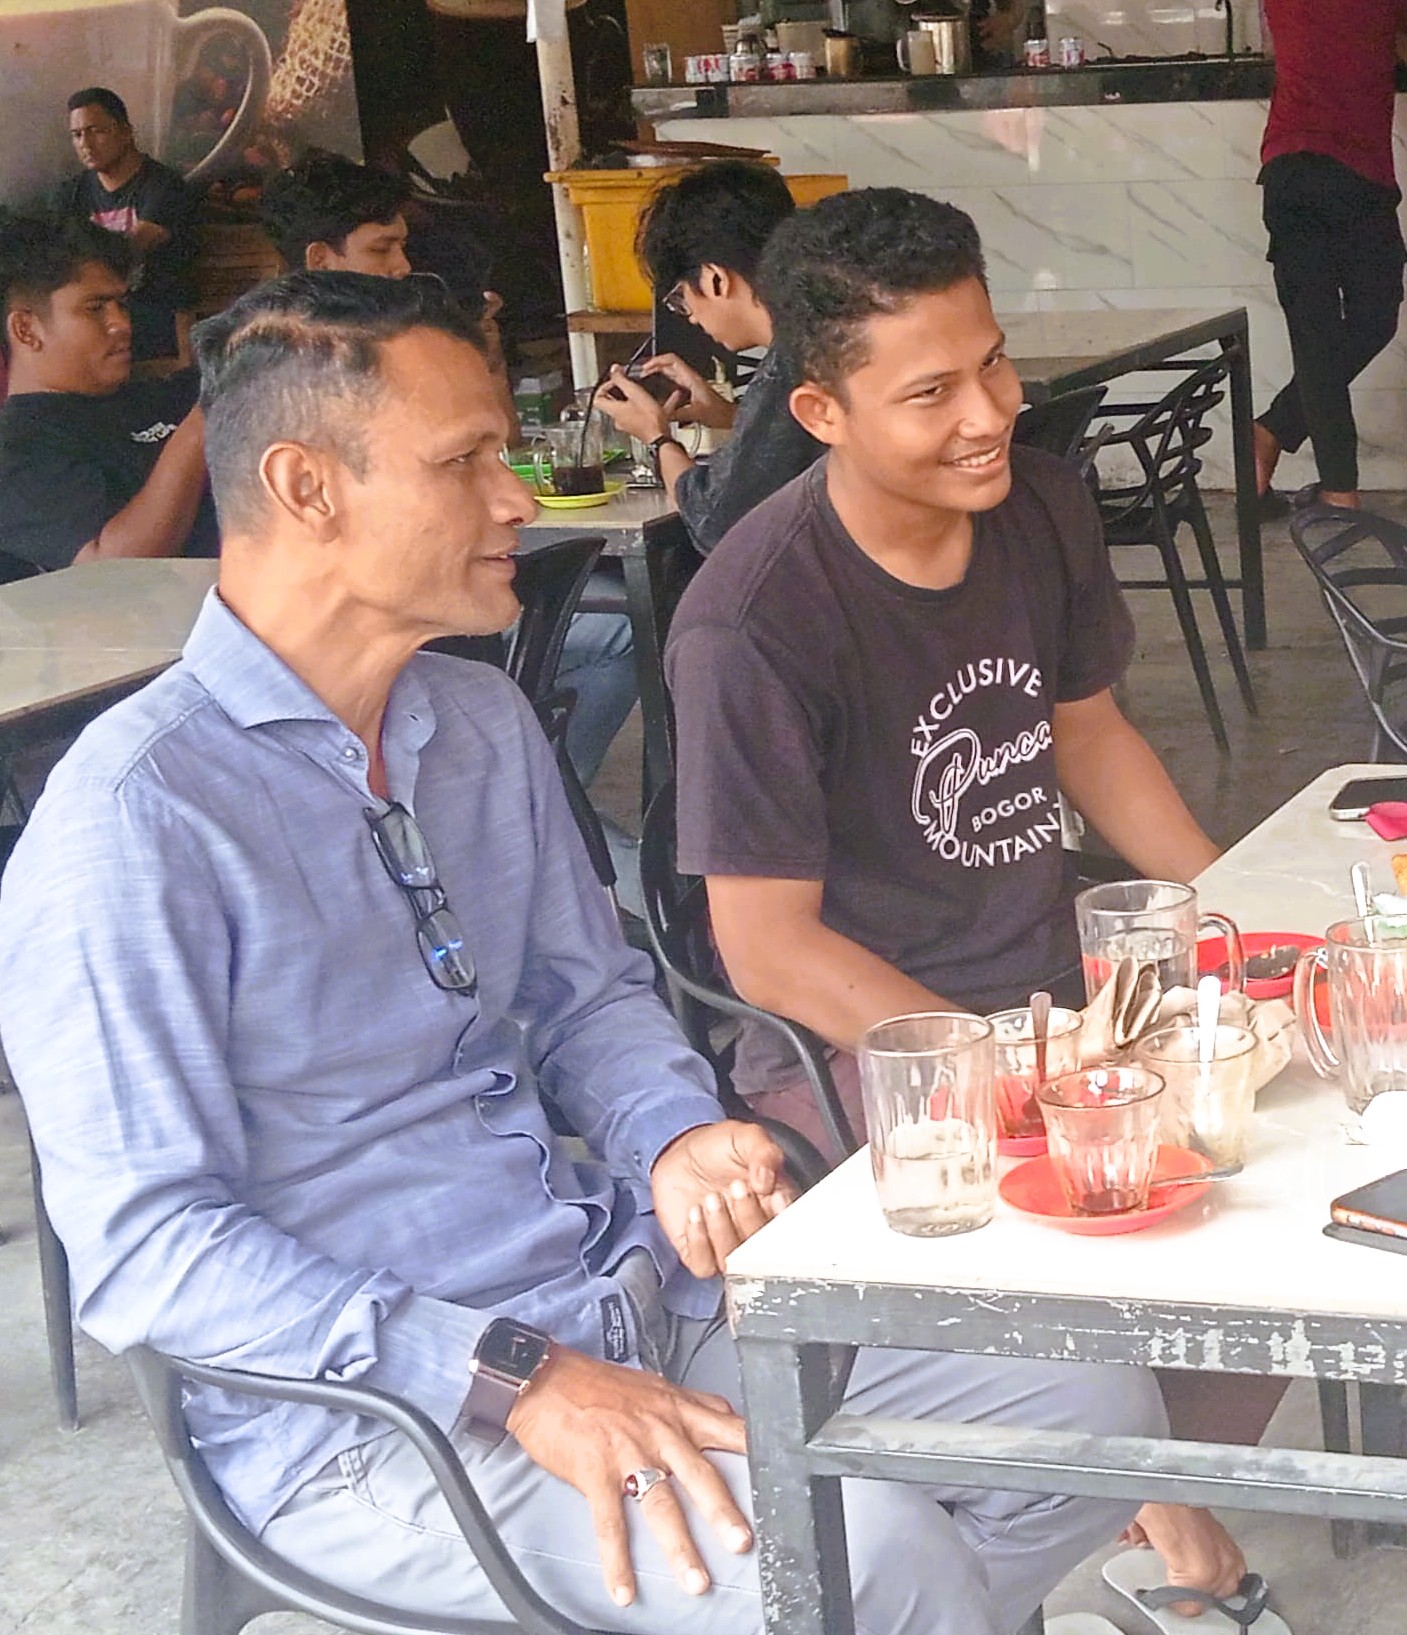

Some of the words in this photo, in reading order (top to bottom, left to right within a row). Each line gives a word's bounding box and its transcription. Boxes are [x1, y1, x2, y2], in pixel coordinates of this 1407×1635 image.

[911, 658, 1042, 757] EXCLUSIVE
[923, 803, 1060, 868] MOUNTAIN
[971, 787, 1047, 833] BOGOR
